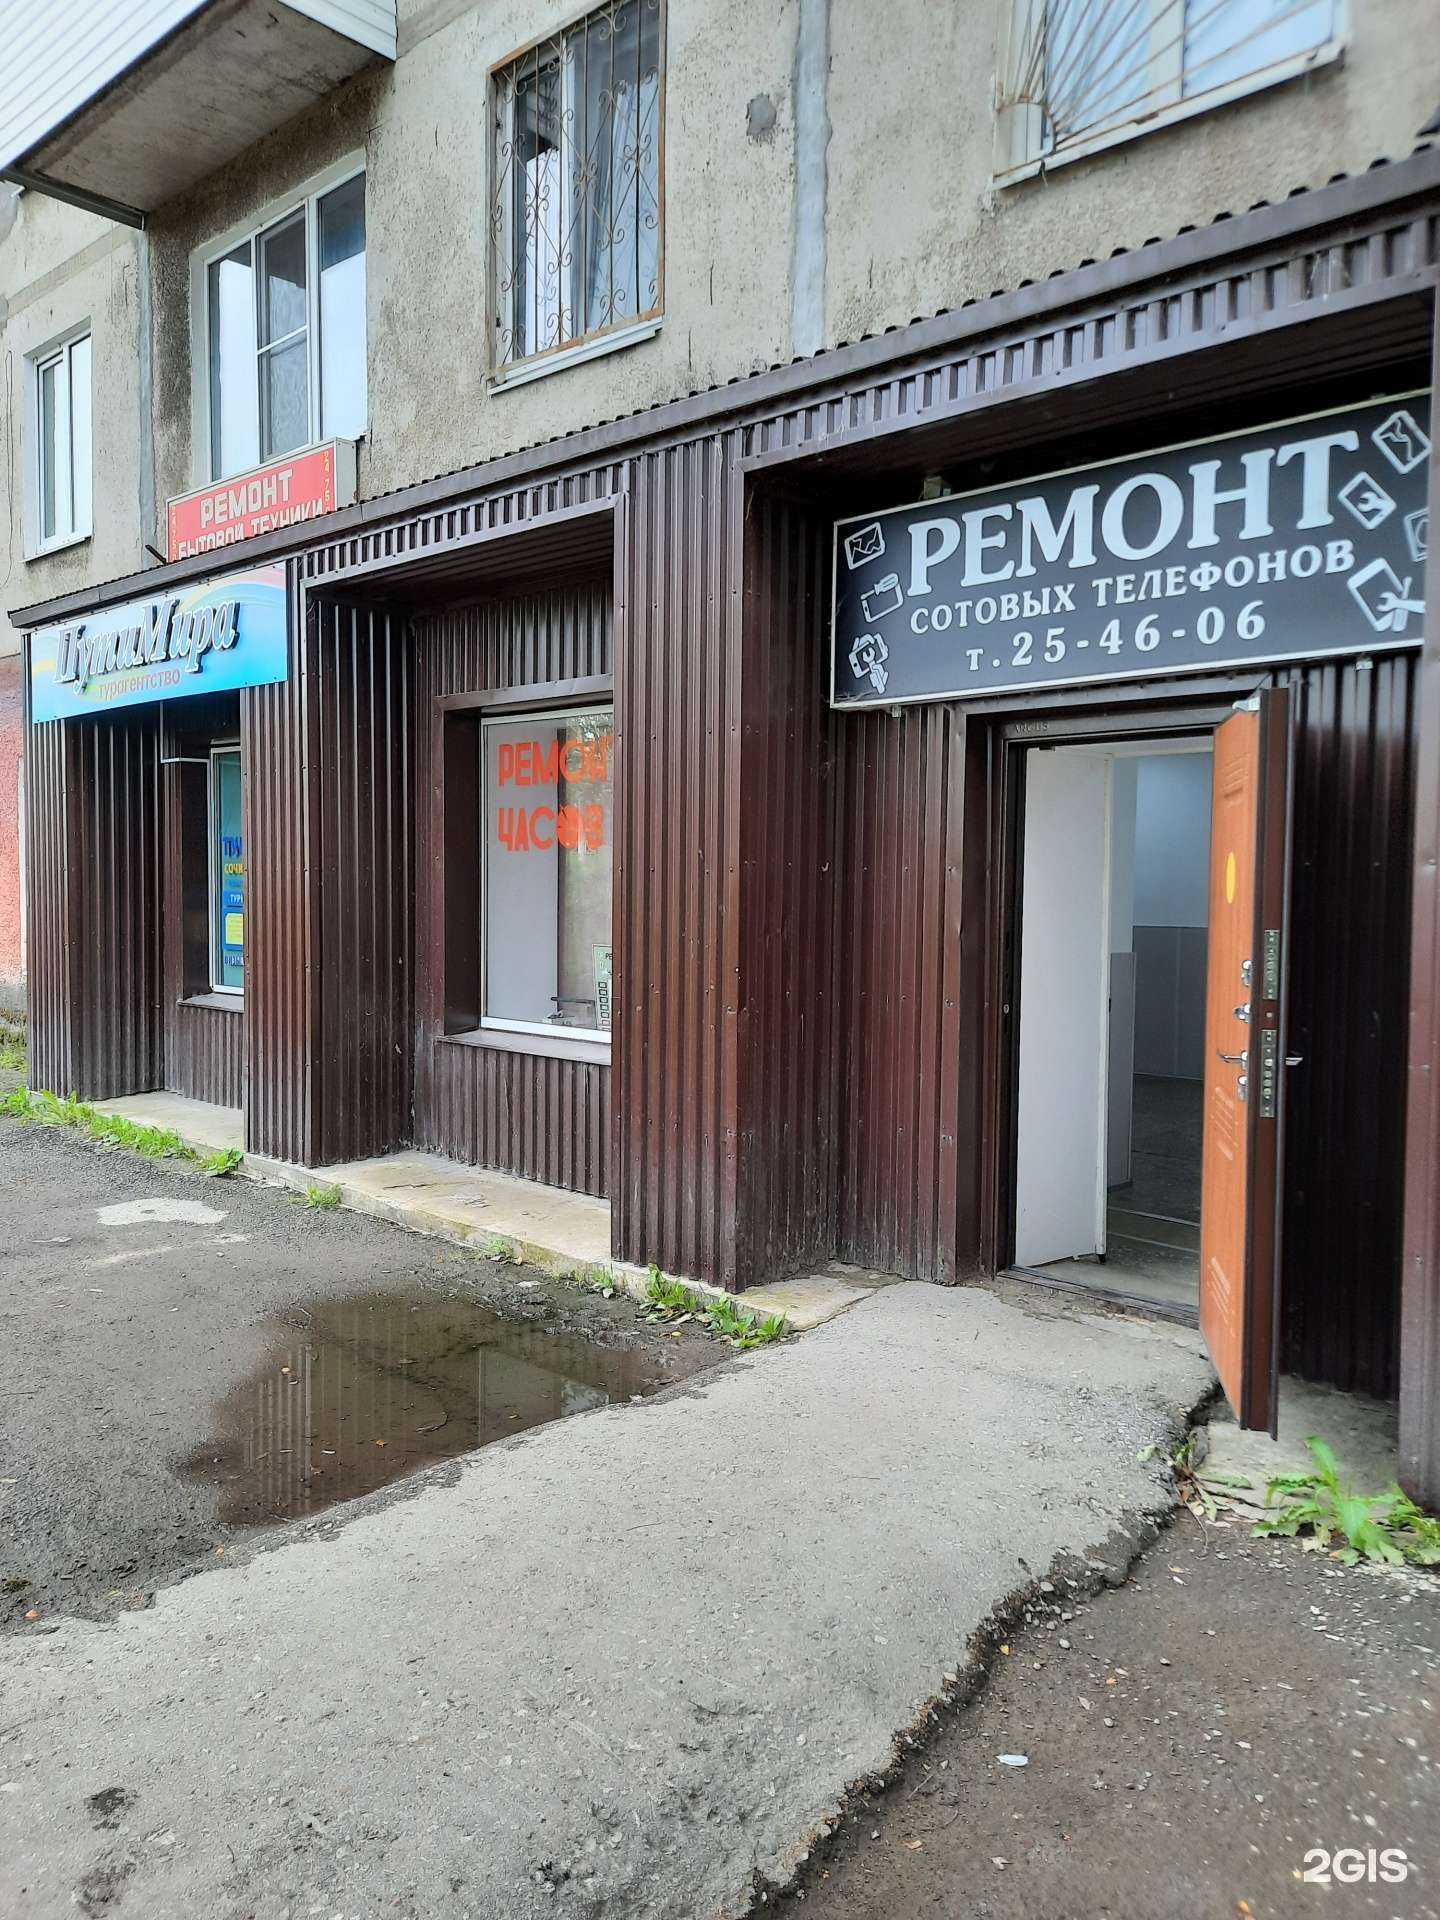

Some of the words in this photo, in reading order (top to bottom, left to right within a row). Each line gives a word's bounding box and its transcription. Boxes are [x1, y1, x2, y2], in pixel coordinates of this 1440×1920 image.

[201, 469, 292, 528] РЕМОНТ
[907, 430, 1359, 597] РЕМОНТ
[911, 584, 1076, 634] СОТОВЫХ
[1092, 539, 1355, 608] ТЕЛЕФОНОВ
[498, 804, 605, 852] ЧАСОВ
